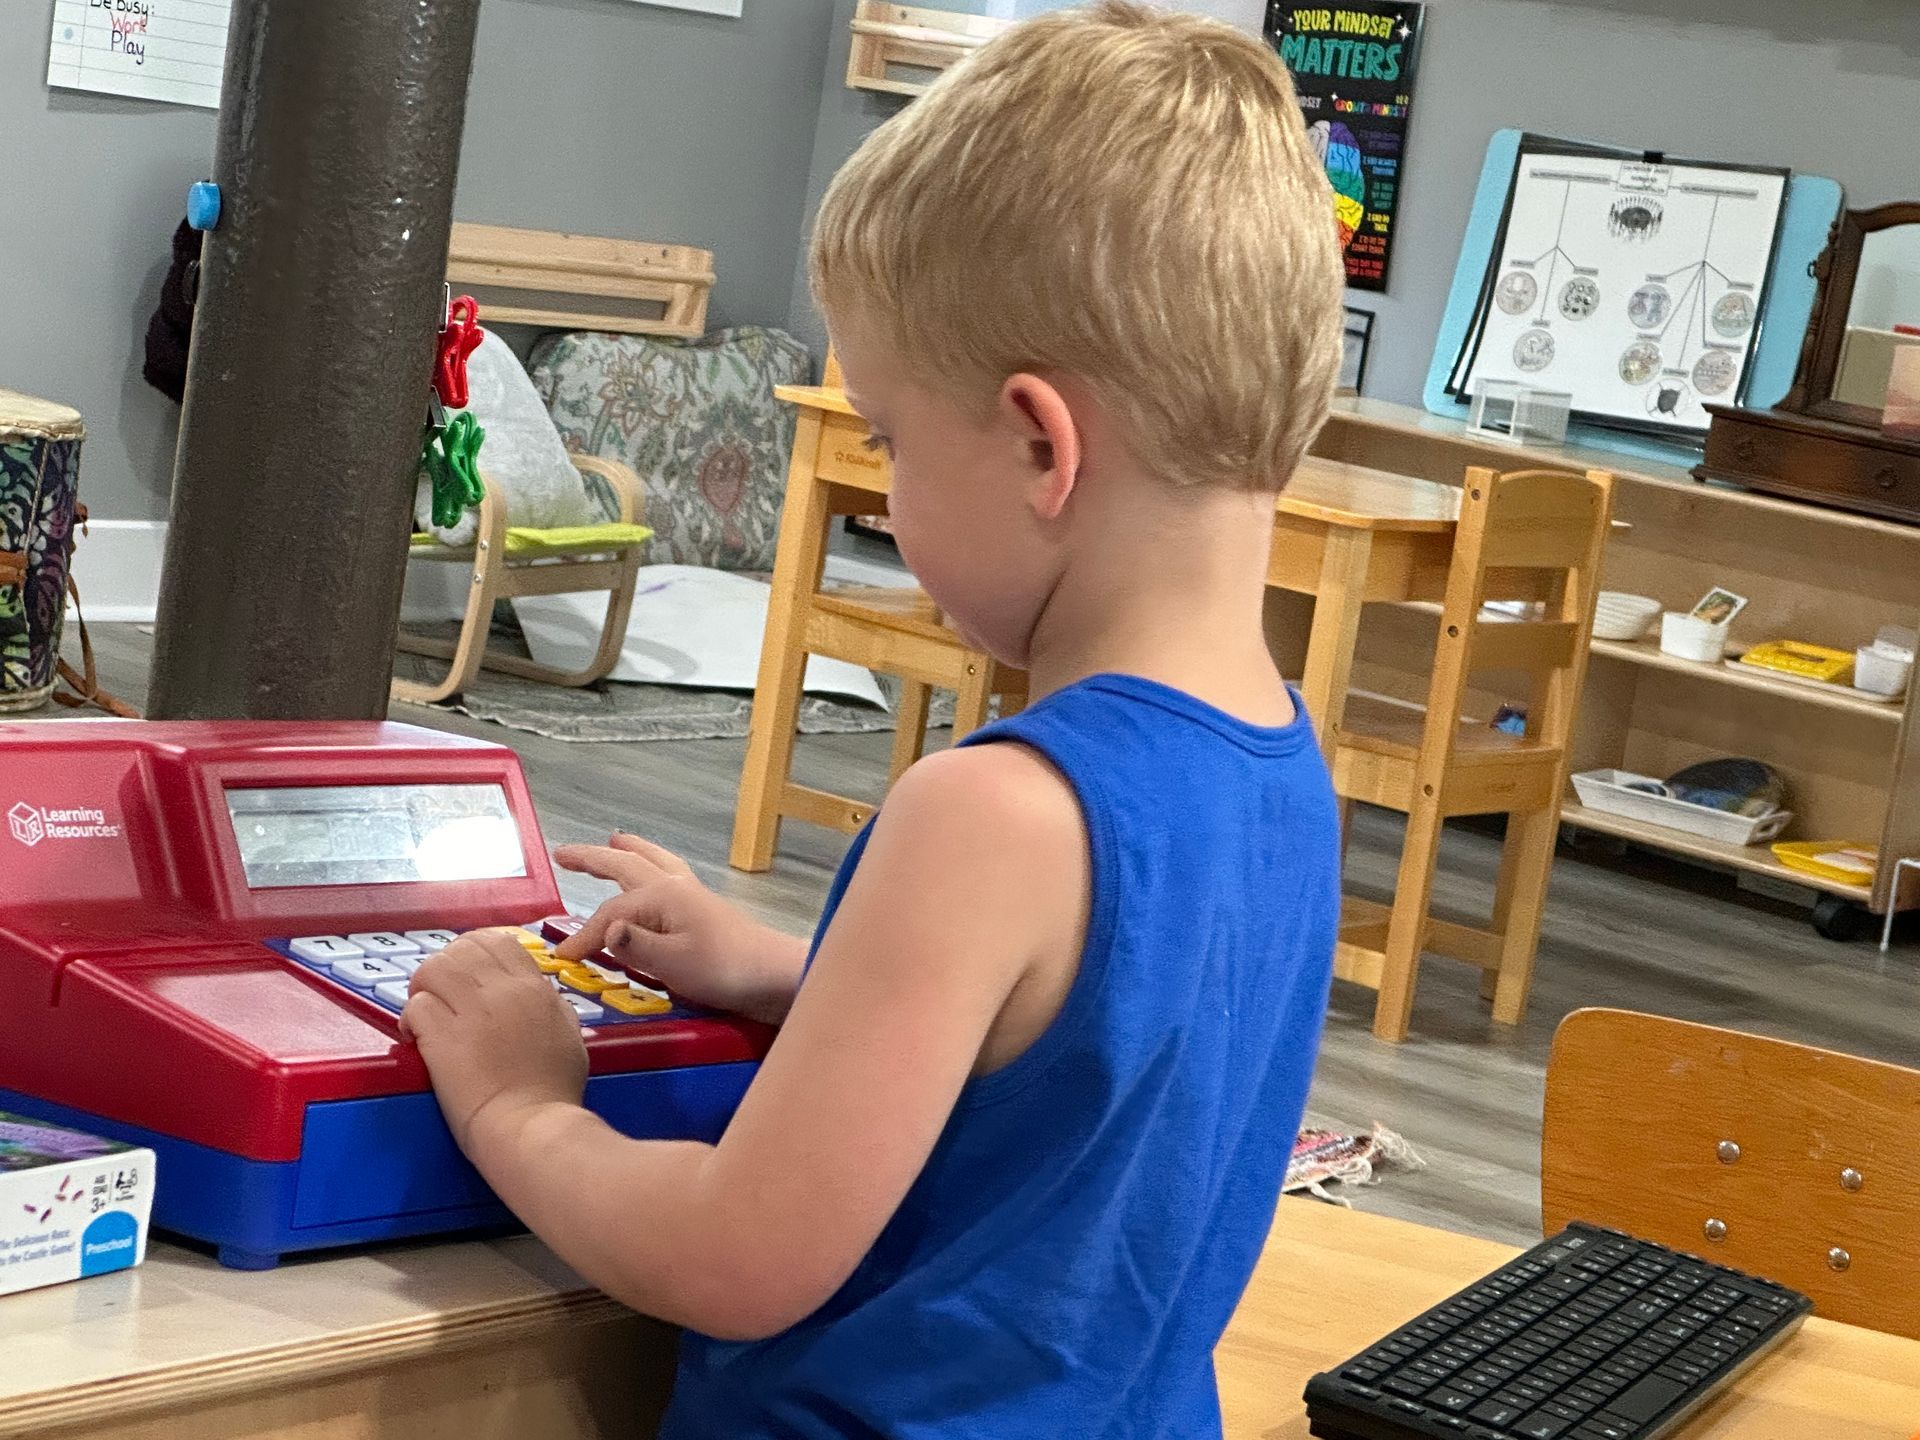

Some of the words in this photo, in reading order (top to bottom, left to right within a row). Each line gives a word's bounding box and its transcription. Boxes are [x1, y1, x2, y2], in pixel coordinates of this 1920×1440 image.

[110, 11, 147, 33] Work
[1293, 9, 1331, 31] YOUR
[112, 30, 145, 65] Play
[1280, 34, 1402, 81] MATTERS
[41, 806, 104, 824] Learning
[45, 822, 118, 838] Resources
[313, 940, 335, 951] 7
[373, 936, 396, 946] 8
[363, 962, 382, 972] 4
[86, 1236, 133, 1256] Preschool
